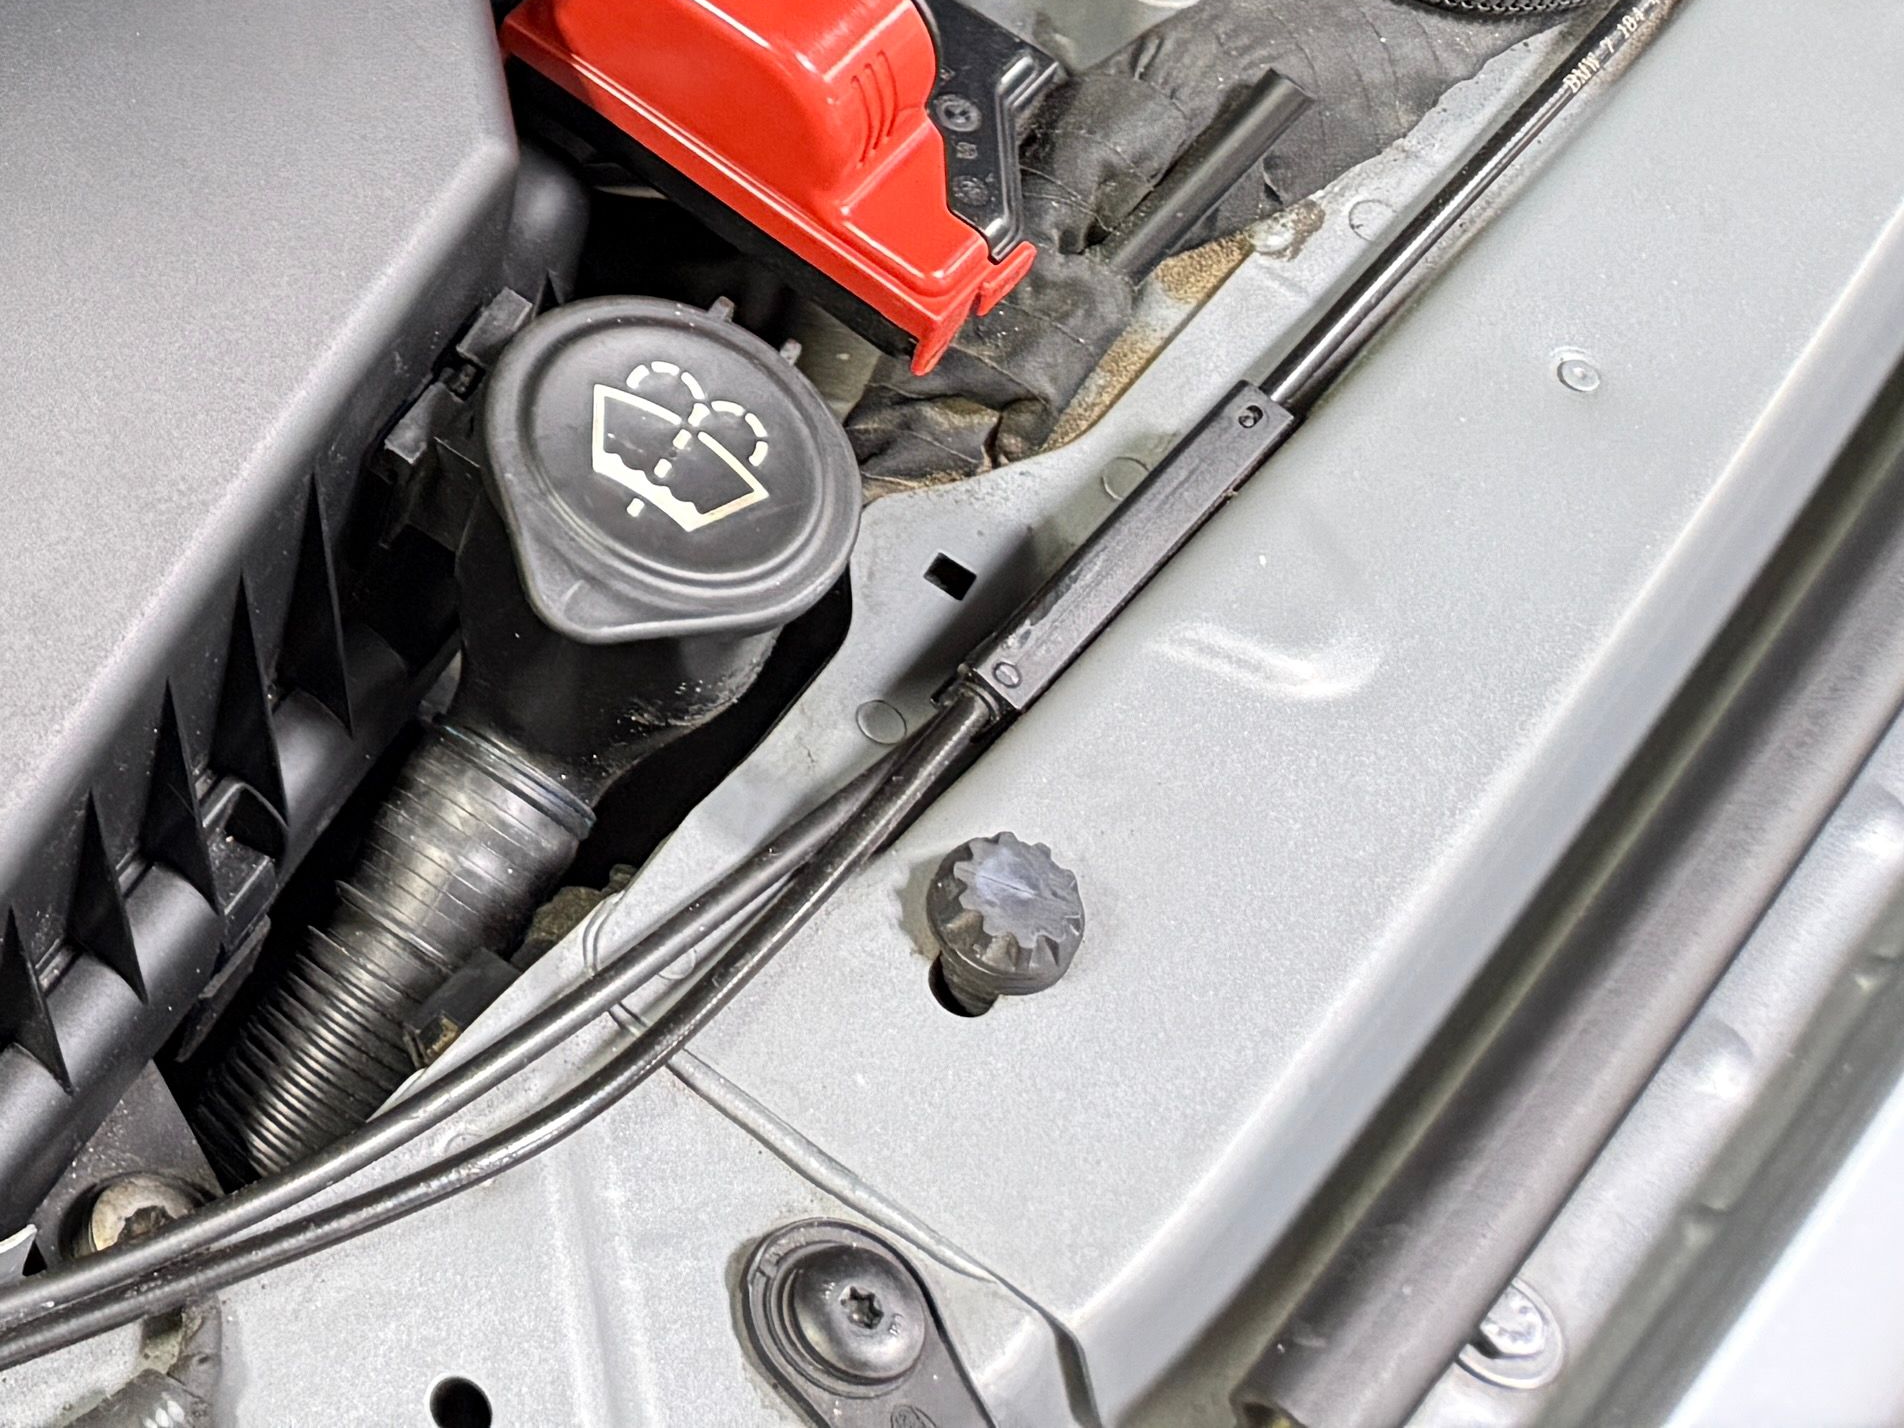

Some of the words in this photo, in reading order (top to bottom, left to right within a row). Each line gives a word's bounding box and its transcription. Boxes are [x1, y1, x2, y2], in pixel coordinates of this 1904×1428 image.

[1562, 52, 1600, 93] BMW
[1599, 36, 1614, 53] 7
[1617, 7, 1645, 39] 184
